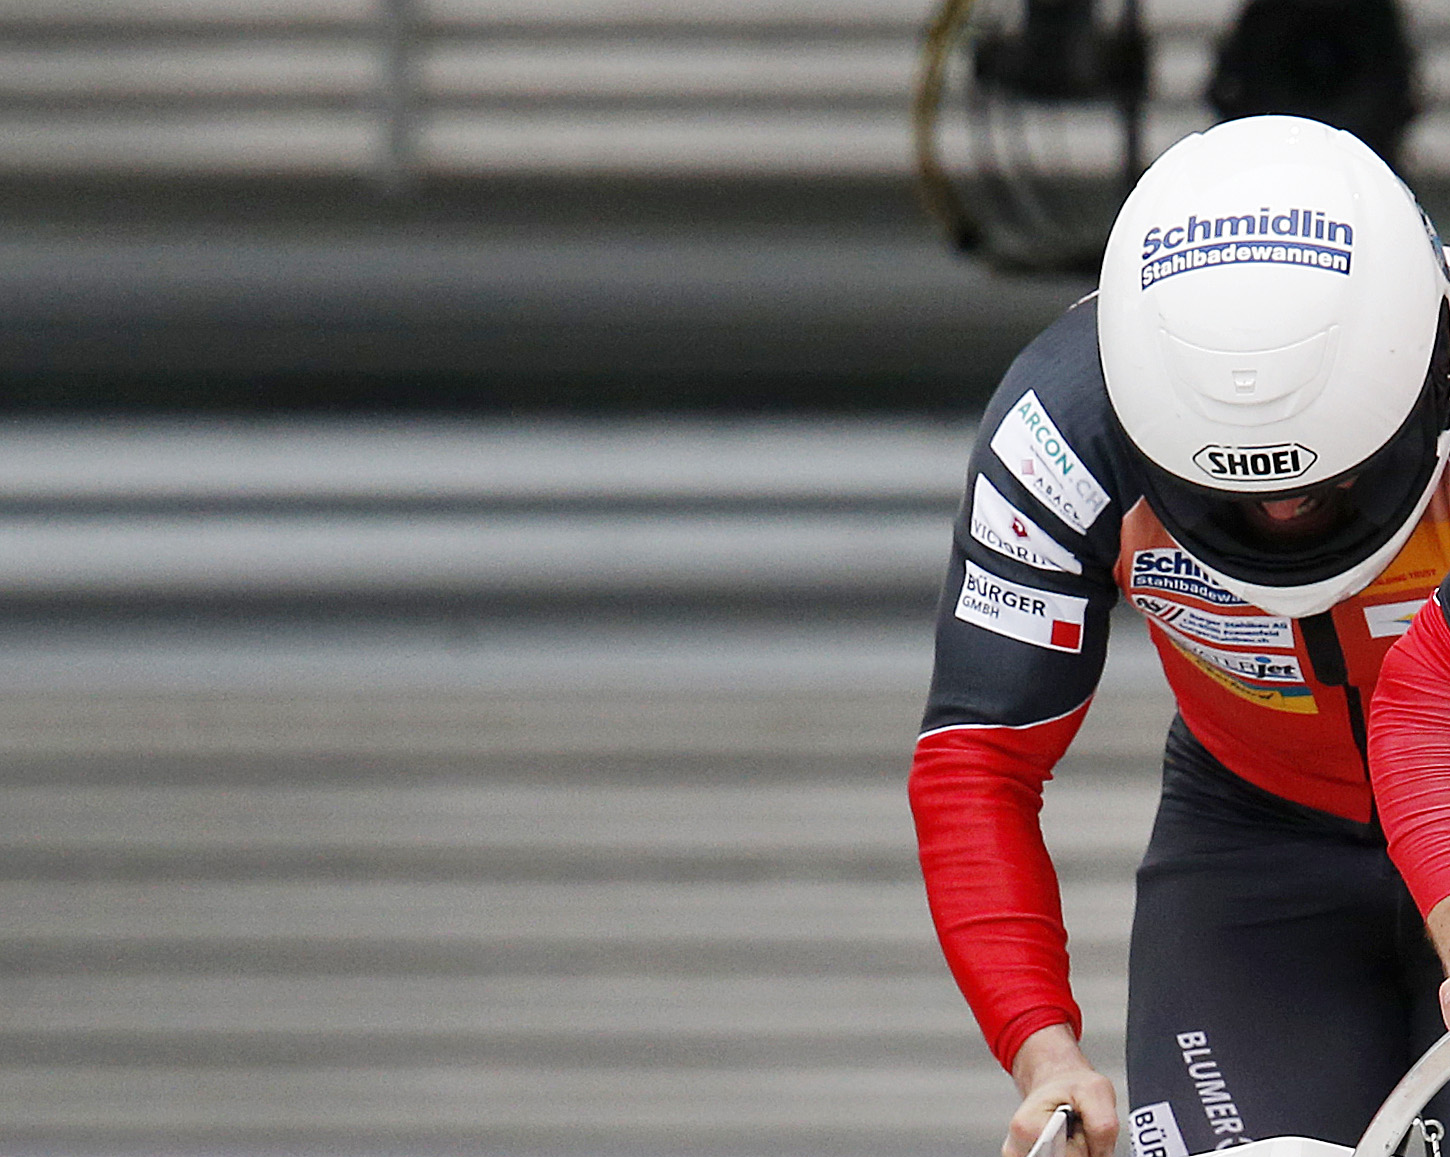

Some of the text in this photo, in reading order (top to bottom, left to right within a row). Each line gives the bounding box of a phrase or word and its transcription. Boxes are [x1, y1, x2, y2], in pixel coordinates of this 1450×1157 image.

[1142, 207, 1354, 260] Schmidlin
[1142, 243, 1349, 288] Stahlbadewannen
[1016, 400, 1101, 511] ARCON.CH
[1207, 449, 1301, 476] SHOEI
[962, 595, 1000, 619] GMBH
[966, 574, 1046, 618] BÜRGER
[1176, 1030, 1246, 1135] BLUMER
